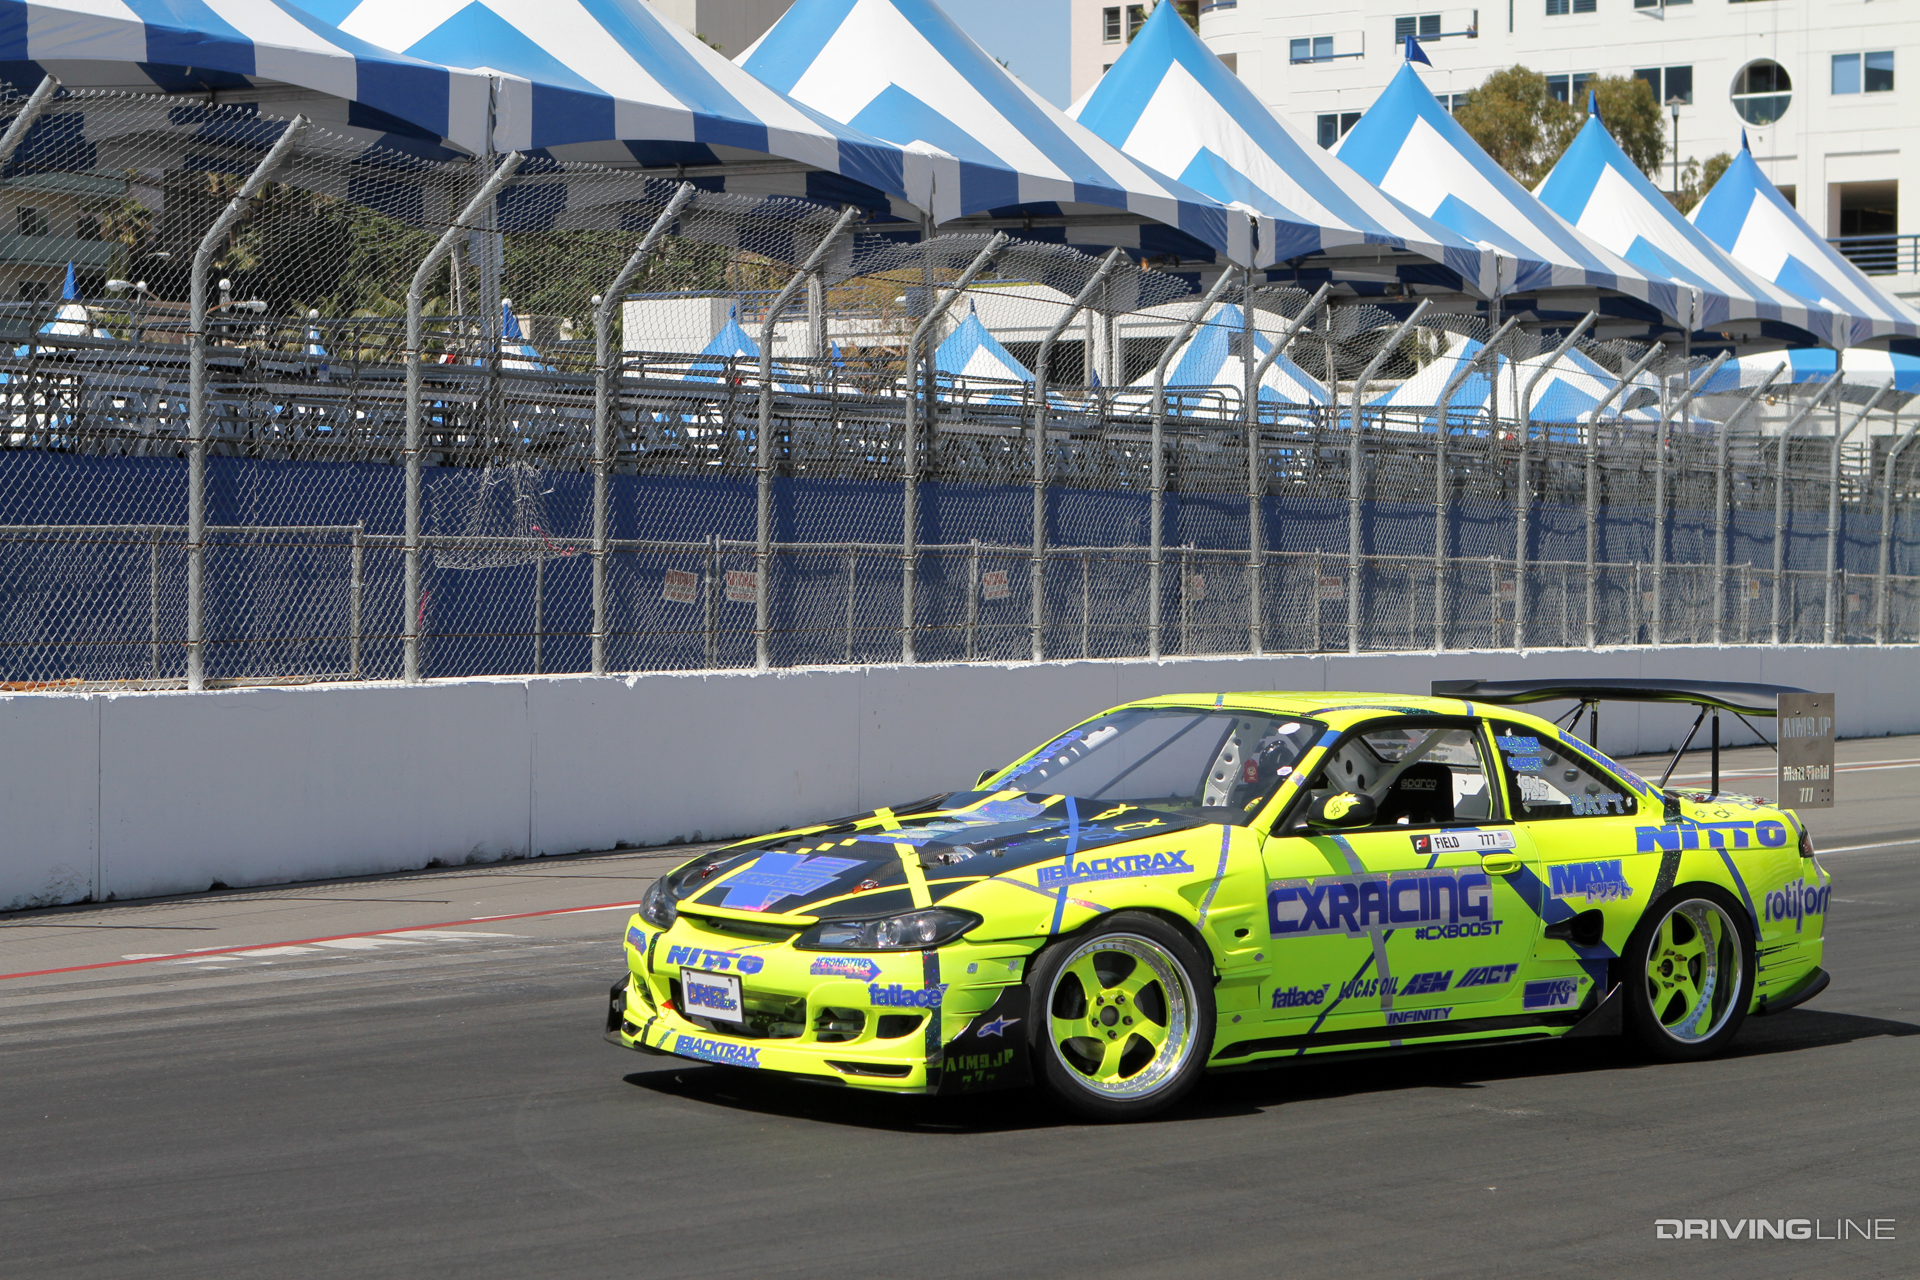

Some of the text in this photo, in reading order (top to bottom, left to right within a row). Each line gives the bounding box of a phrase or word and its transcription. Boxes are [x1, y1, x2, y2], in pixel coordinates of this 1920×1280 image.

[1401, 778, 1437, 789] sparco
[1783, 764, 1830, 781] Matt Field
[1799, 787, 1814, 803] 777
[1434, 836, 1460, 849] FIELD
[1478, 834, 1496, 845] 777
[1636, 820, 1787, 853] NITTO
[1550, 860, 1622, 895] MAX
[1586, 881, 1631, 900] ドリフト
[1267, 874, 1489, 935] CXRACING
[1415, 919, 1504, 941] #CXBOOST
[666, 945, 765, 975] NITTO
[1339, 976, 1400, 999] LUCAS OIL
[1397, 970, 1455, 997] AEM
[868, 983, 943, 1008] fatlace
[1271, 985, 1326, 1009] fatlace
[1388, 1006, 1454, 1025] INFINITY
[945, 1048, 1014, 1073] AIM9.JP
